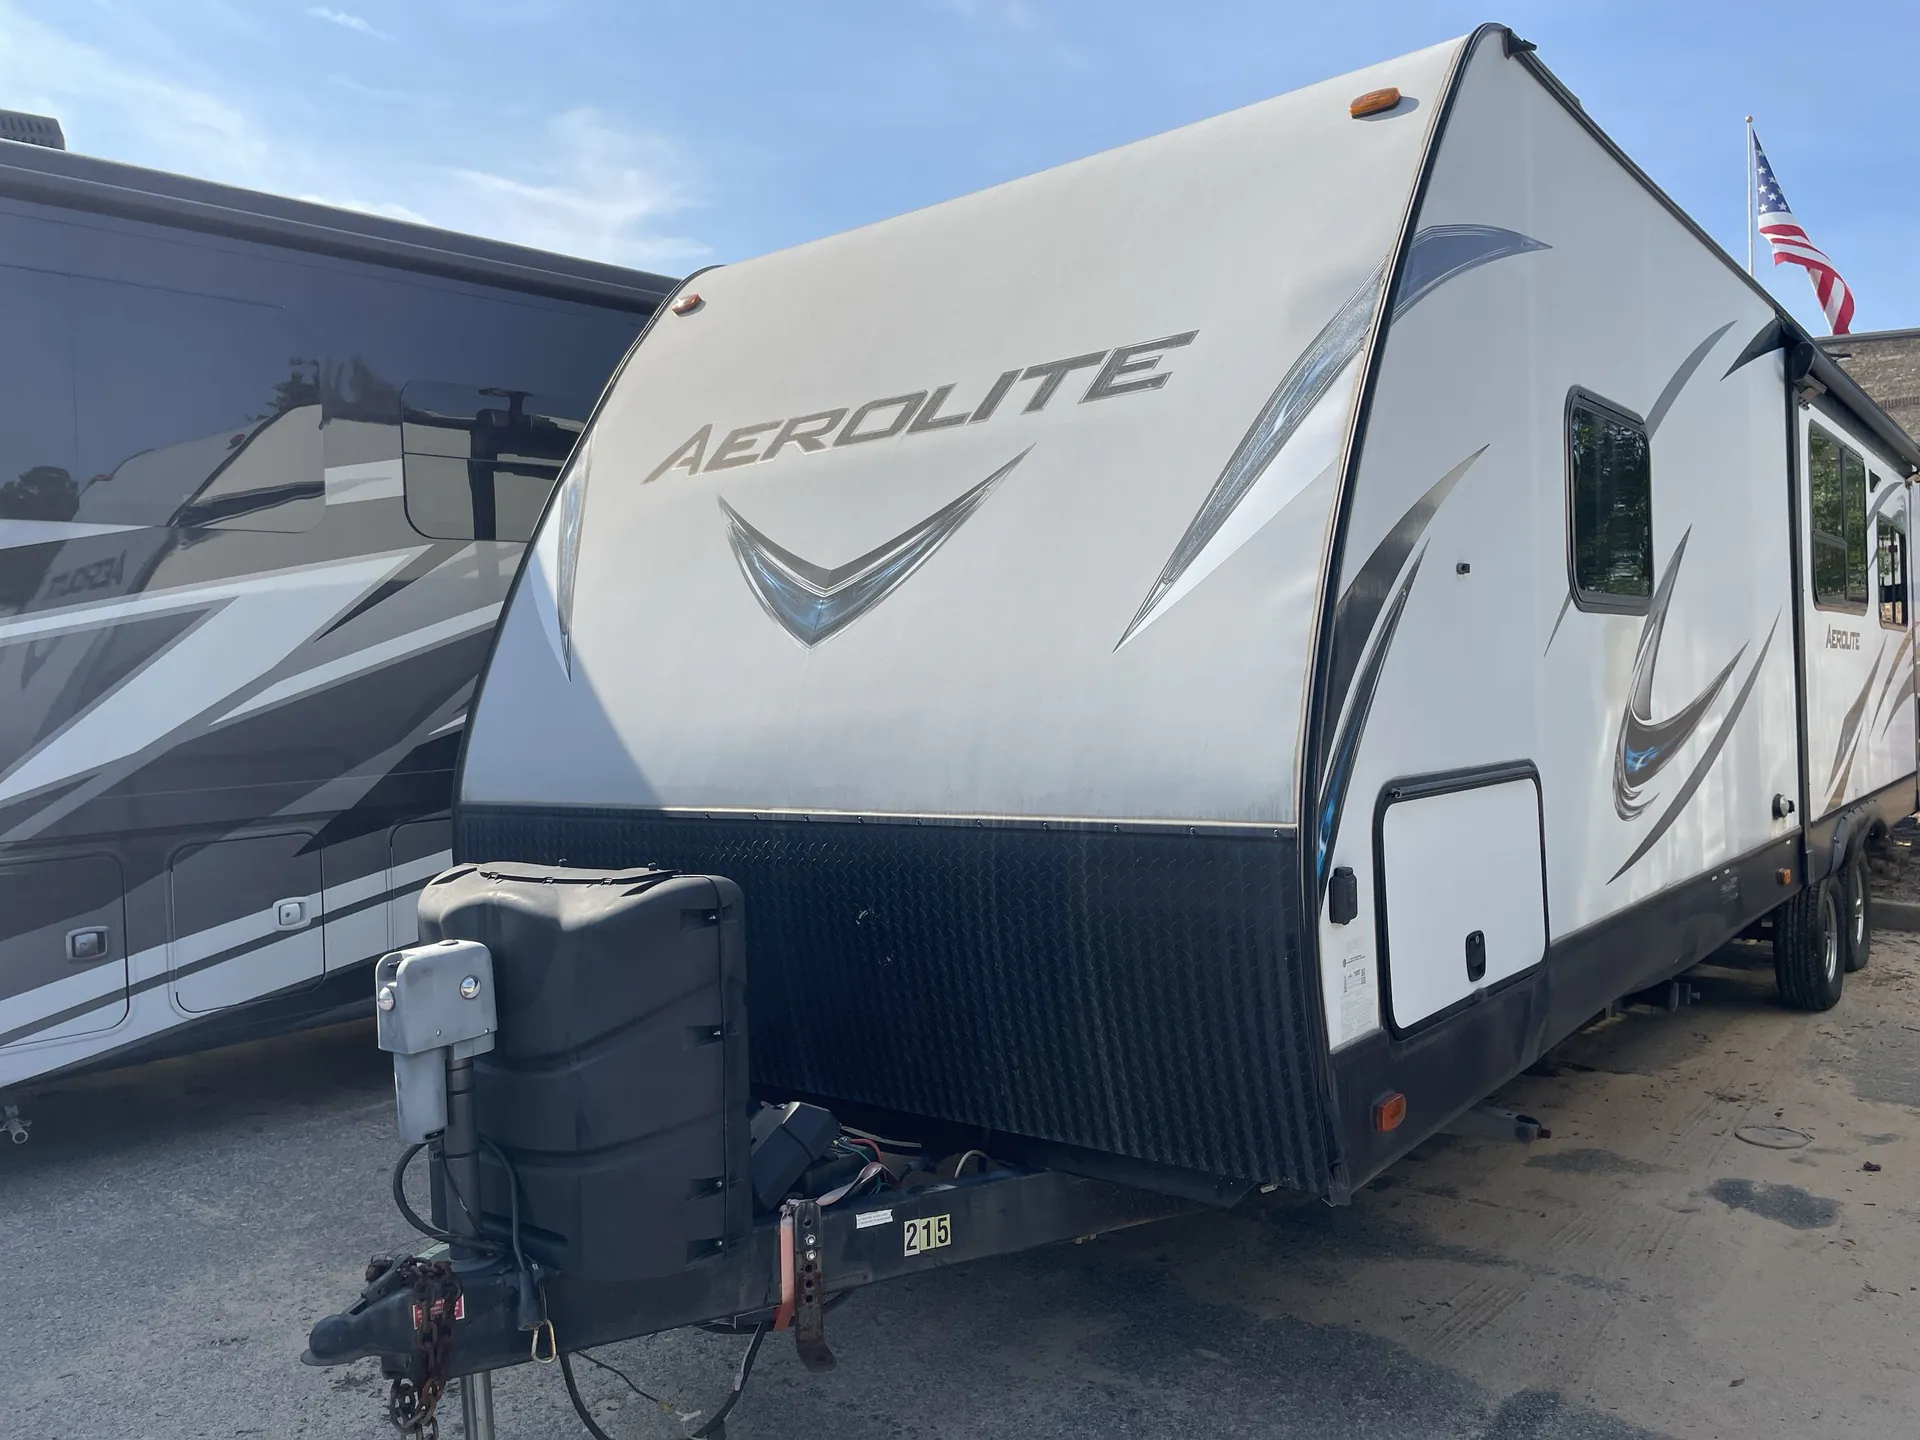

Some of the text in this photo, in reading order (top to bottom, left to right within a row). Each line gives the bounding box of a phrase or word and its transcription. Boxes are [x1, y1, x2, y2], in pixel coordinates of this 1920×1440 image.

[640, 329, 1200, 486] AEROLITE
[1825, 623, 1861, 651] AEROLITE
[906, 1216, 949, 1251] 215
